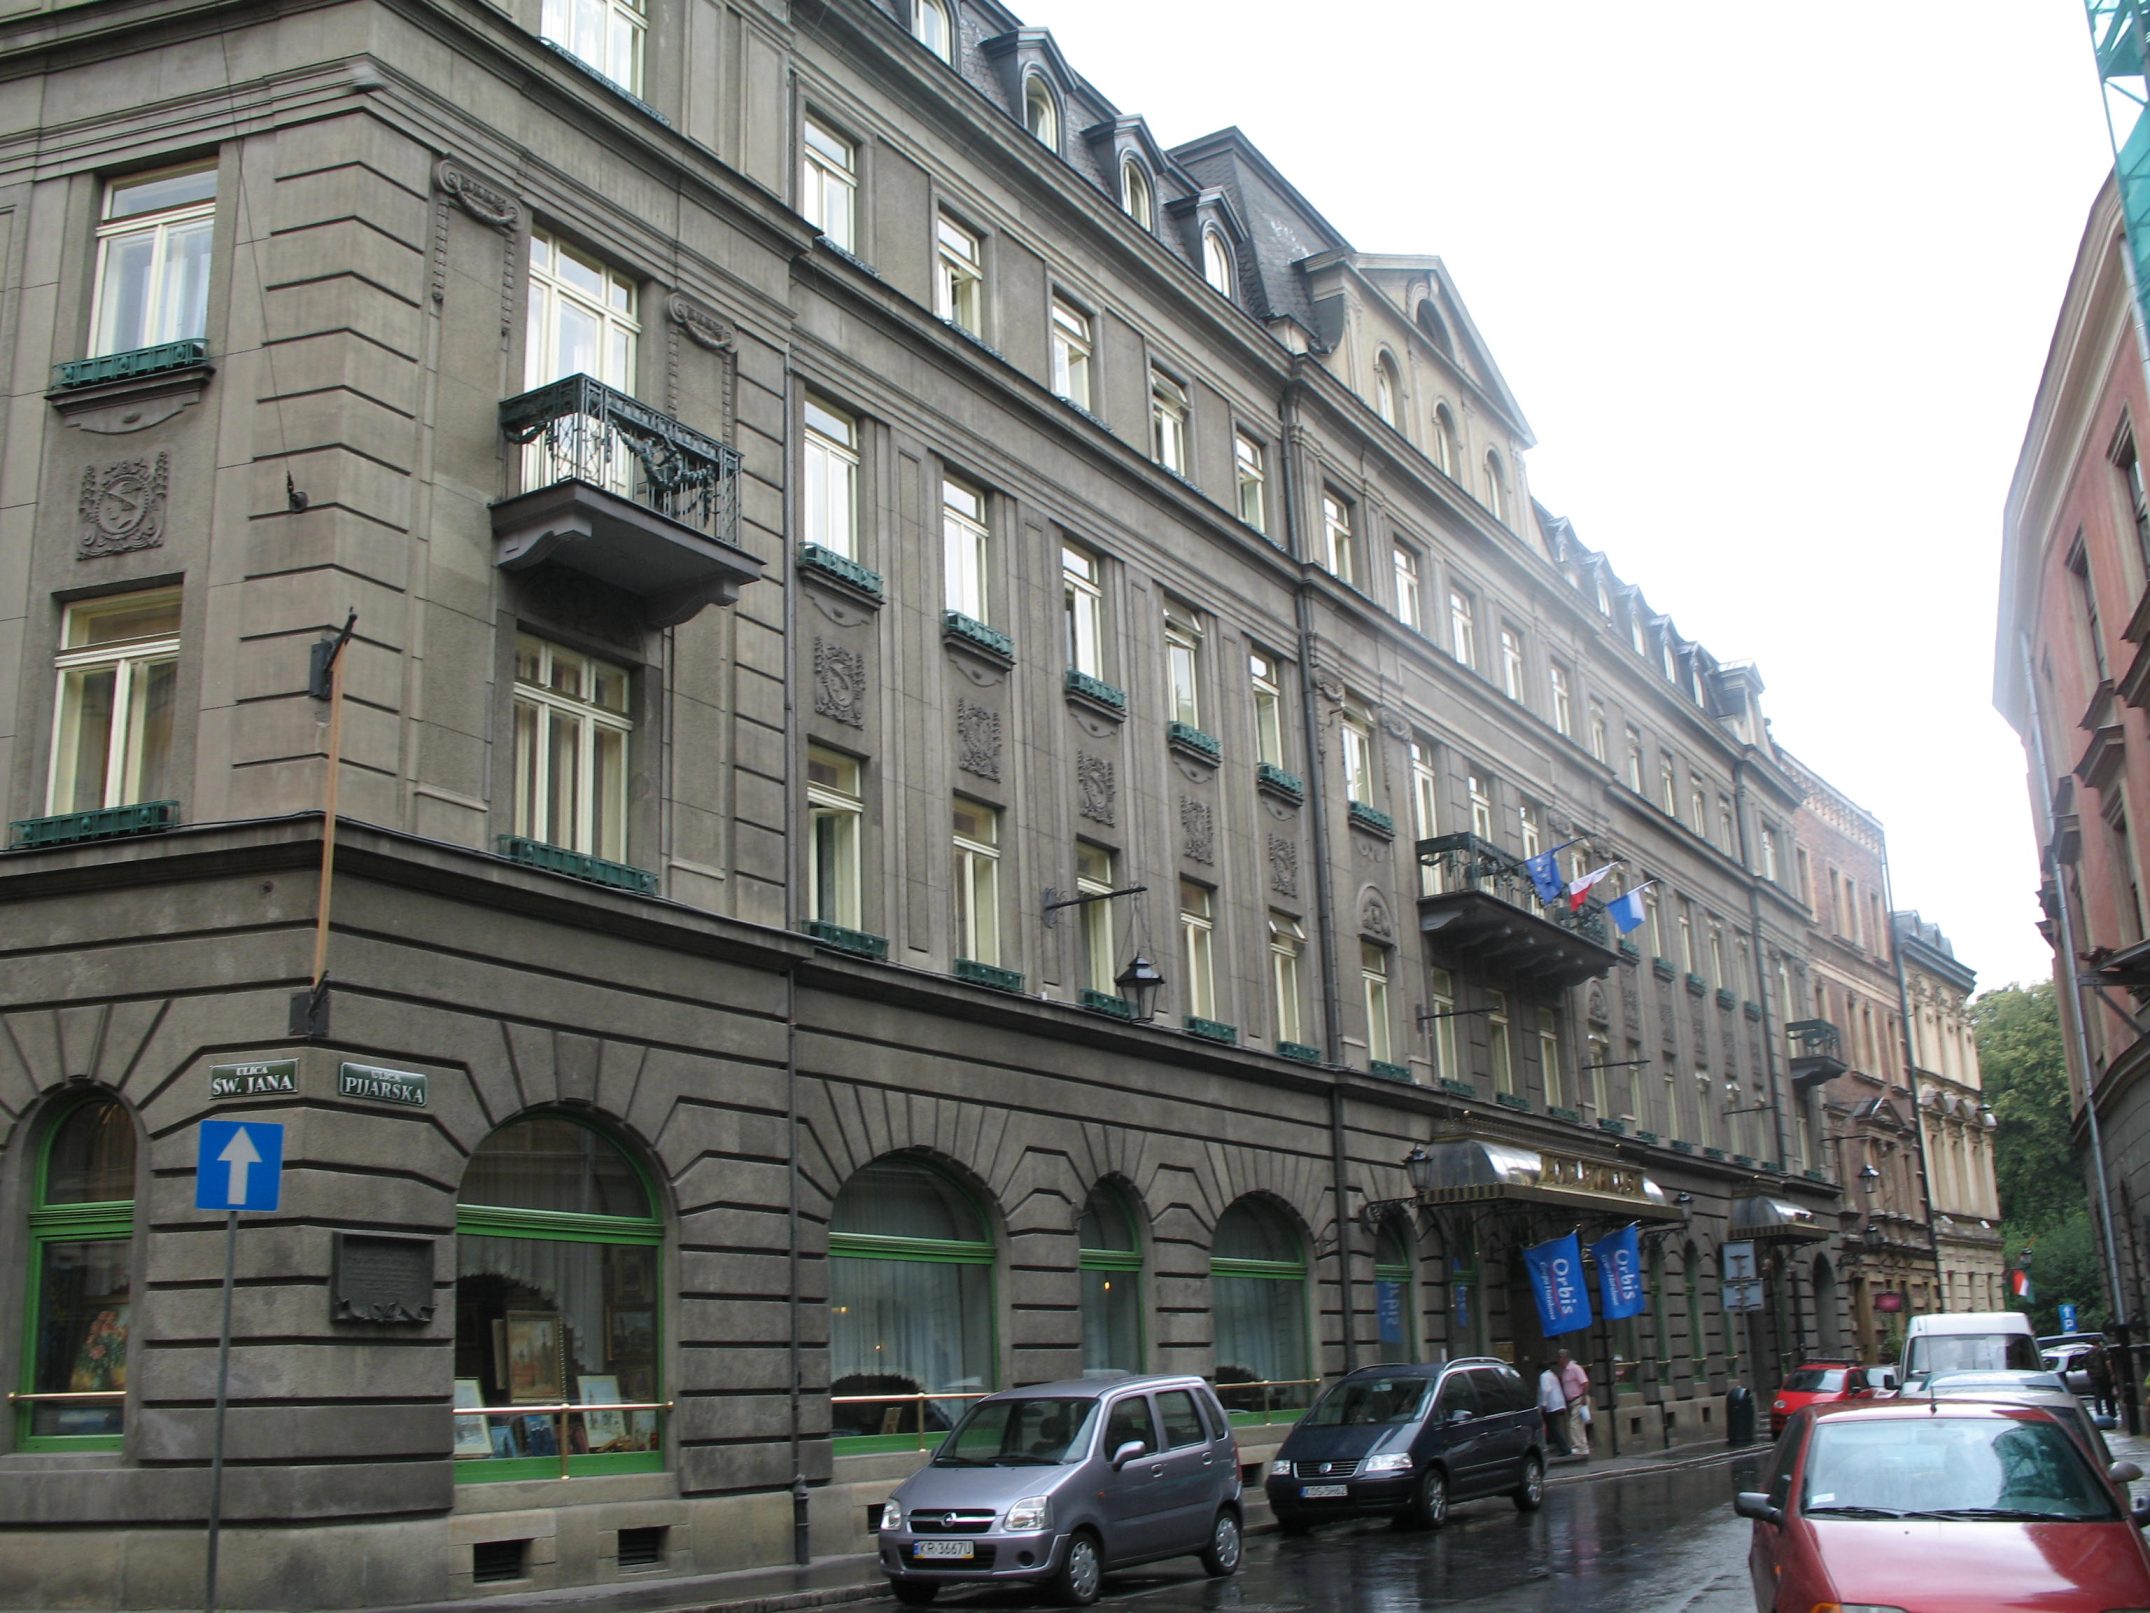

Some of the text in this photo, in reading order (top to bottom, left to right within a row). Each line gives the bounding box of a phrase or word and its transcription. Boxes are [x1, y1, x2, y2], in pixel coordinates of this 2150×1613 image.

[236, 1066, 268, 1076] ULICA
[245, 1074, 294, 1094] JANA
[344, 1076, 424, 1104] PIJARSKA
[1614, 1248, 1639, 1300] Orbis
[1552, 1258, 1577, 1315] Orbis
[2064, 1318, 2075, 1331] P
